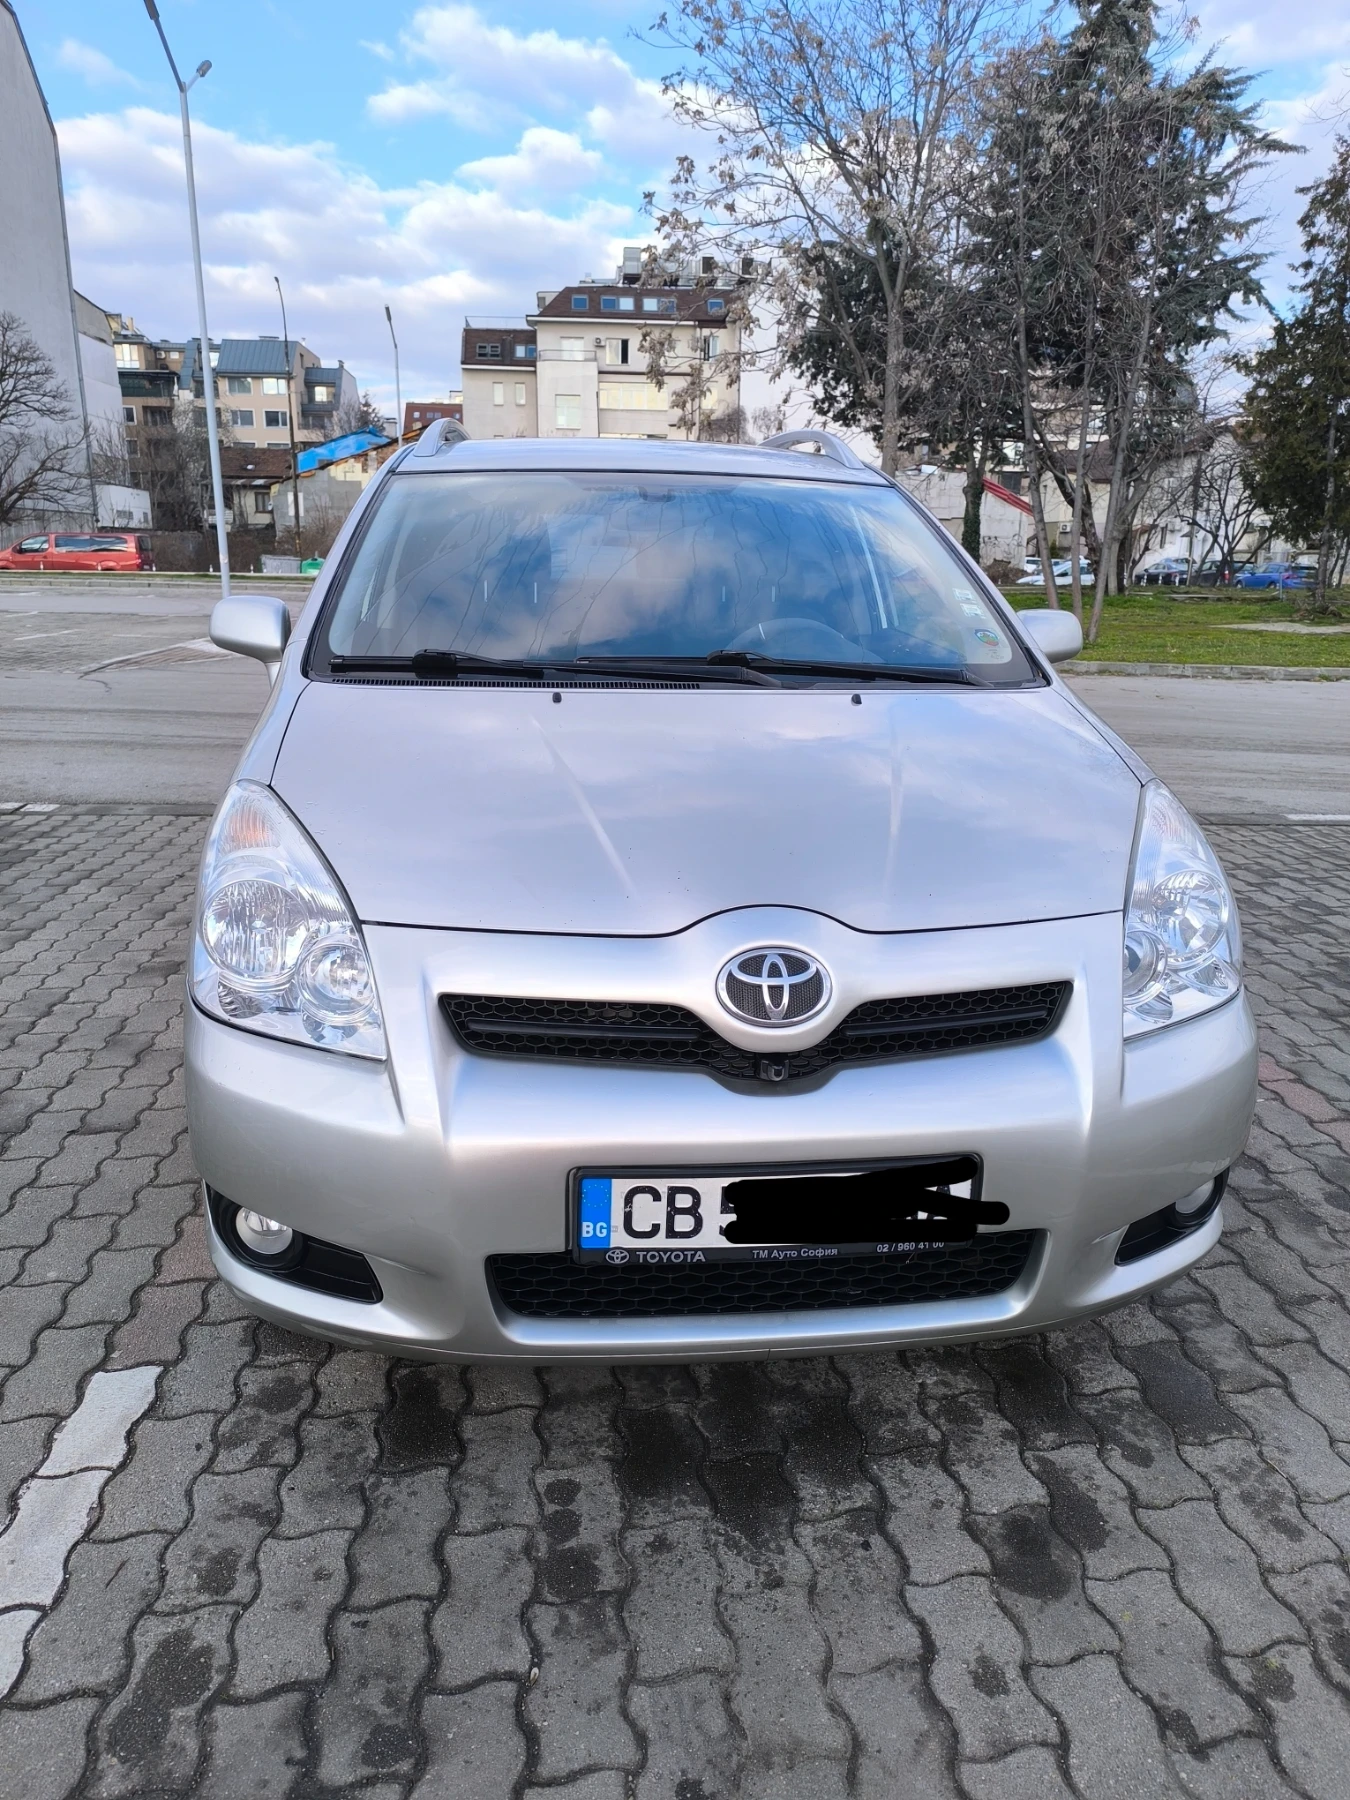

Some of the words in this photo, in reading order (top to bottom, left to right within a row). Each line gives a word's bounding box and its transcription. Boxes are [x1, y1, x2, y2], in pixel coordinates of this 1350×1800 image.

[623, 1185, 703, 1239] CB
[582, 1221, 608, 1237] BG
[876, 1244, 889, 1252] 02
[897, 1242, 916, 1251] 960
[918, 1241, 929, 1250] 41
[636, 1250, 706, 1263] TOYOTA
[752, 1249, 769, 1259] ТМ
[771, 1249, 798, 1260] Ауто
[800, 1247, 838, 1258] София
